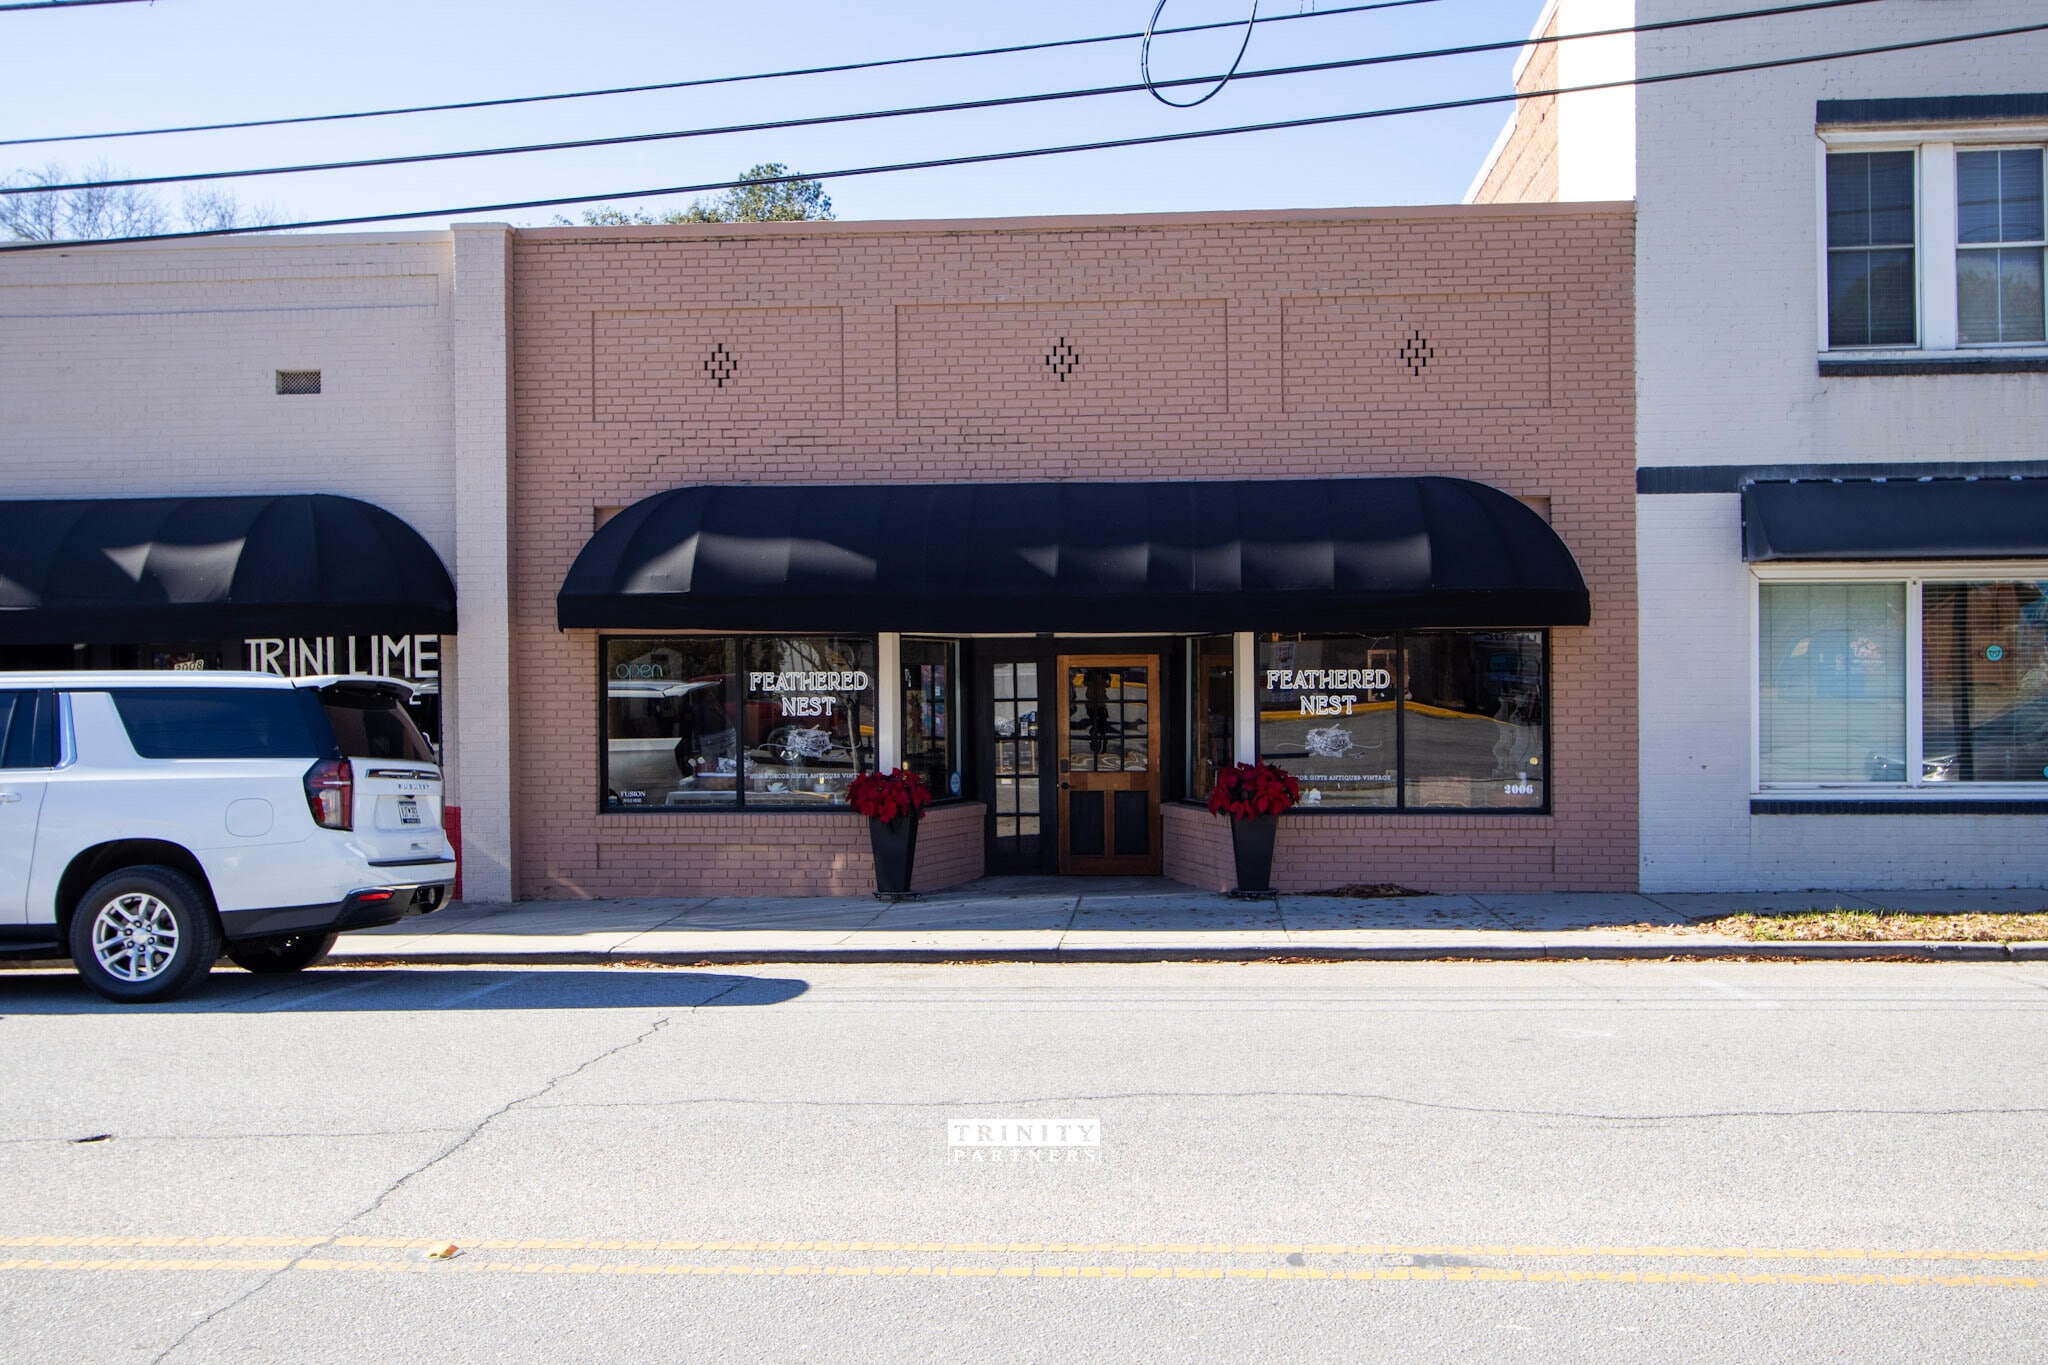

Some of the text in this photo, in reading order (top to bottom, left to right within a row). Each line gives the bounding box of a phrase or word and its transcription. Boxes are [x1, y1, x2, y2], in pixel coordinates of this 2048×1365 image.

[175, 660, 203, 671] 2008
[244, 634, 438, 679] TRINI LIME
[615, 663, 664, 682] open
[749, 671, 869, 691] FEATHERED
[1266, 669, 1391, 690] FEATHERED
[781, 696, 836, 717] NEST
[1299, 695, 1357, 716] NEST
[620, 790, 646, 798] FUSION
[1503, 784, 1534, 796] 2006
